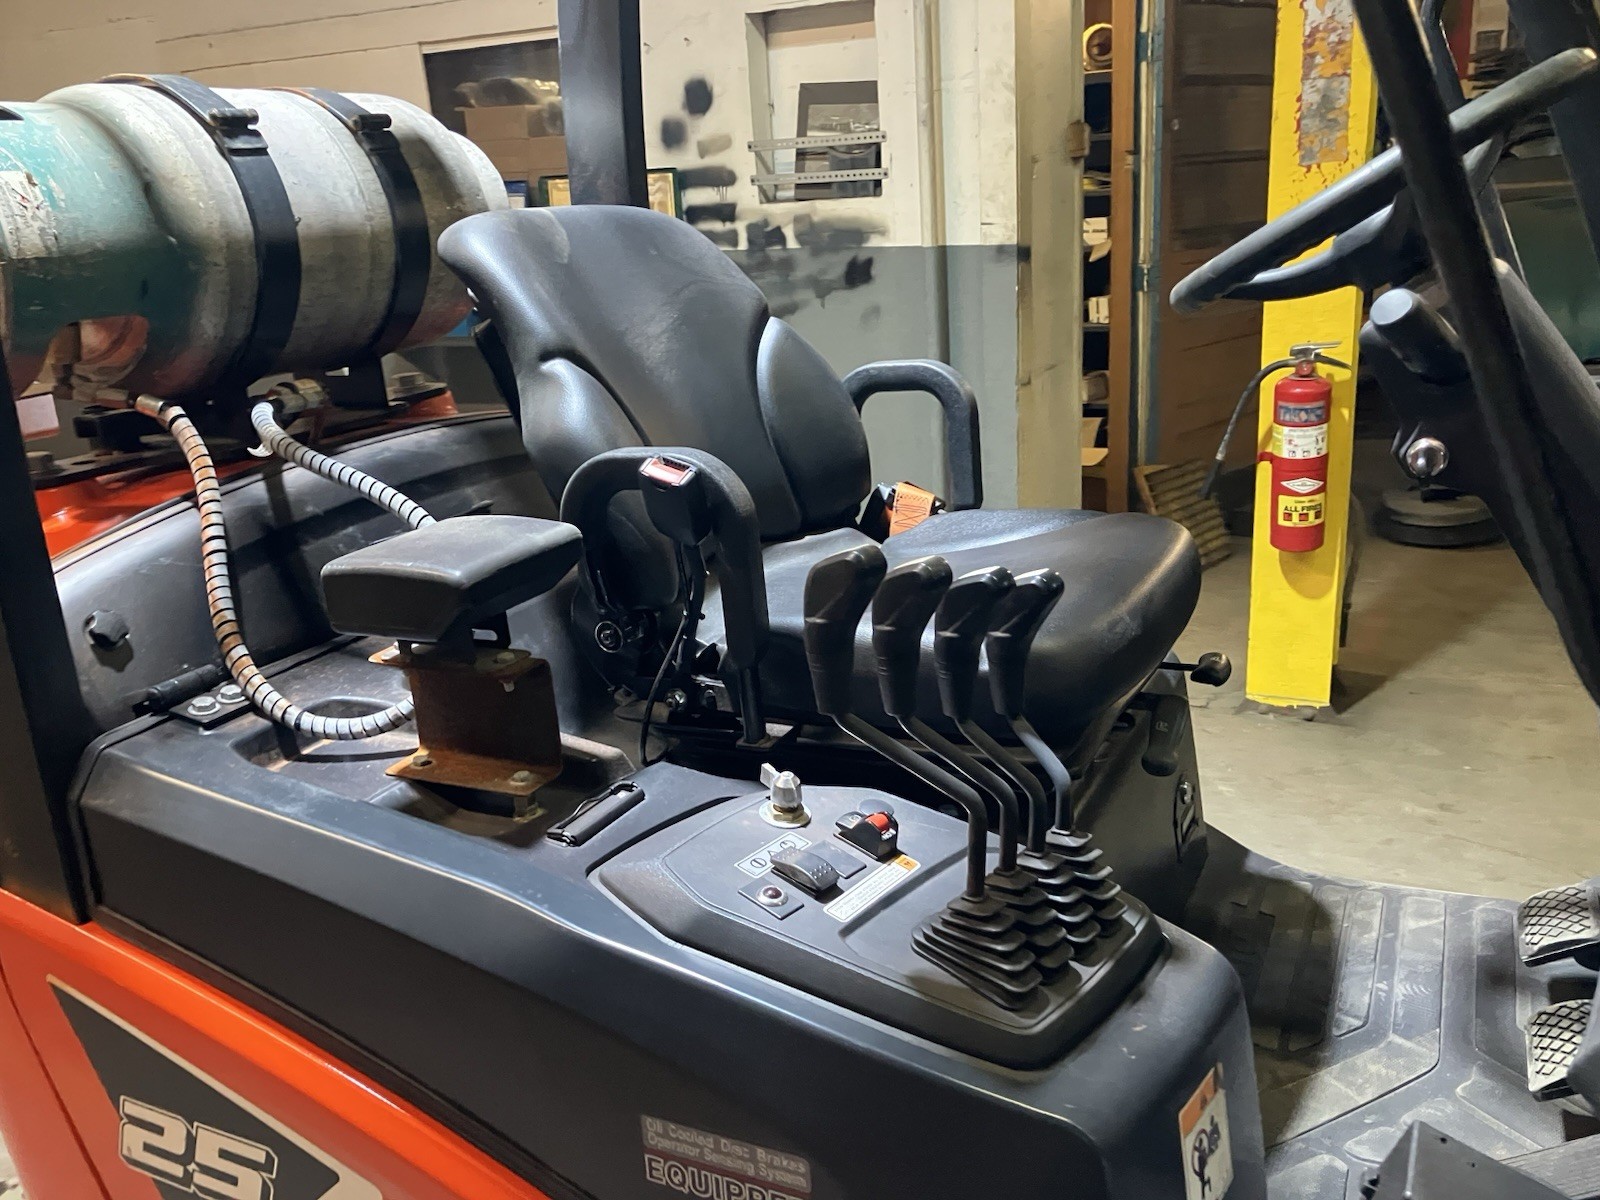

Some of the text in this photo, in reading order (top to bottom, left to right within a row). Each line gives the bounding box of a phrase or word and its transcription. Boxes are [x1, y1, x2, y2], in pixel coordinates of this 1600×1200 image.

[119, 1095, 279, 1200] 25
[646, 1117, 663, 1134] Oil
[669, 1124, 715, 1149] Cooled
[756, 1147, 807, 1174] Brakes
[647, 1131, 700, 1157] Operator
[644, 1154, 804, 1200] EQUIPP
